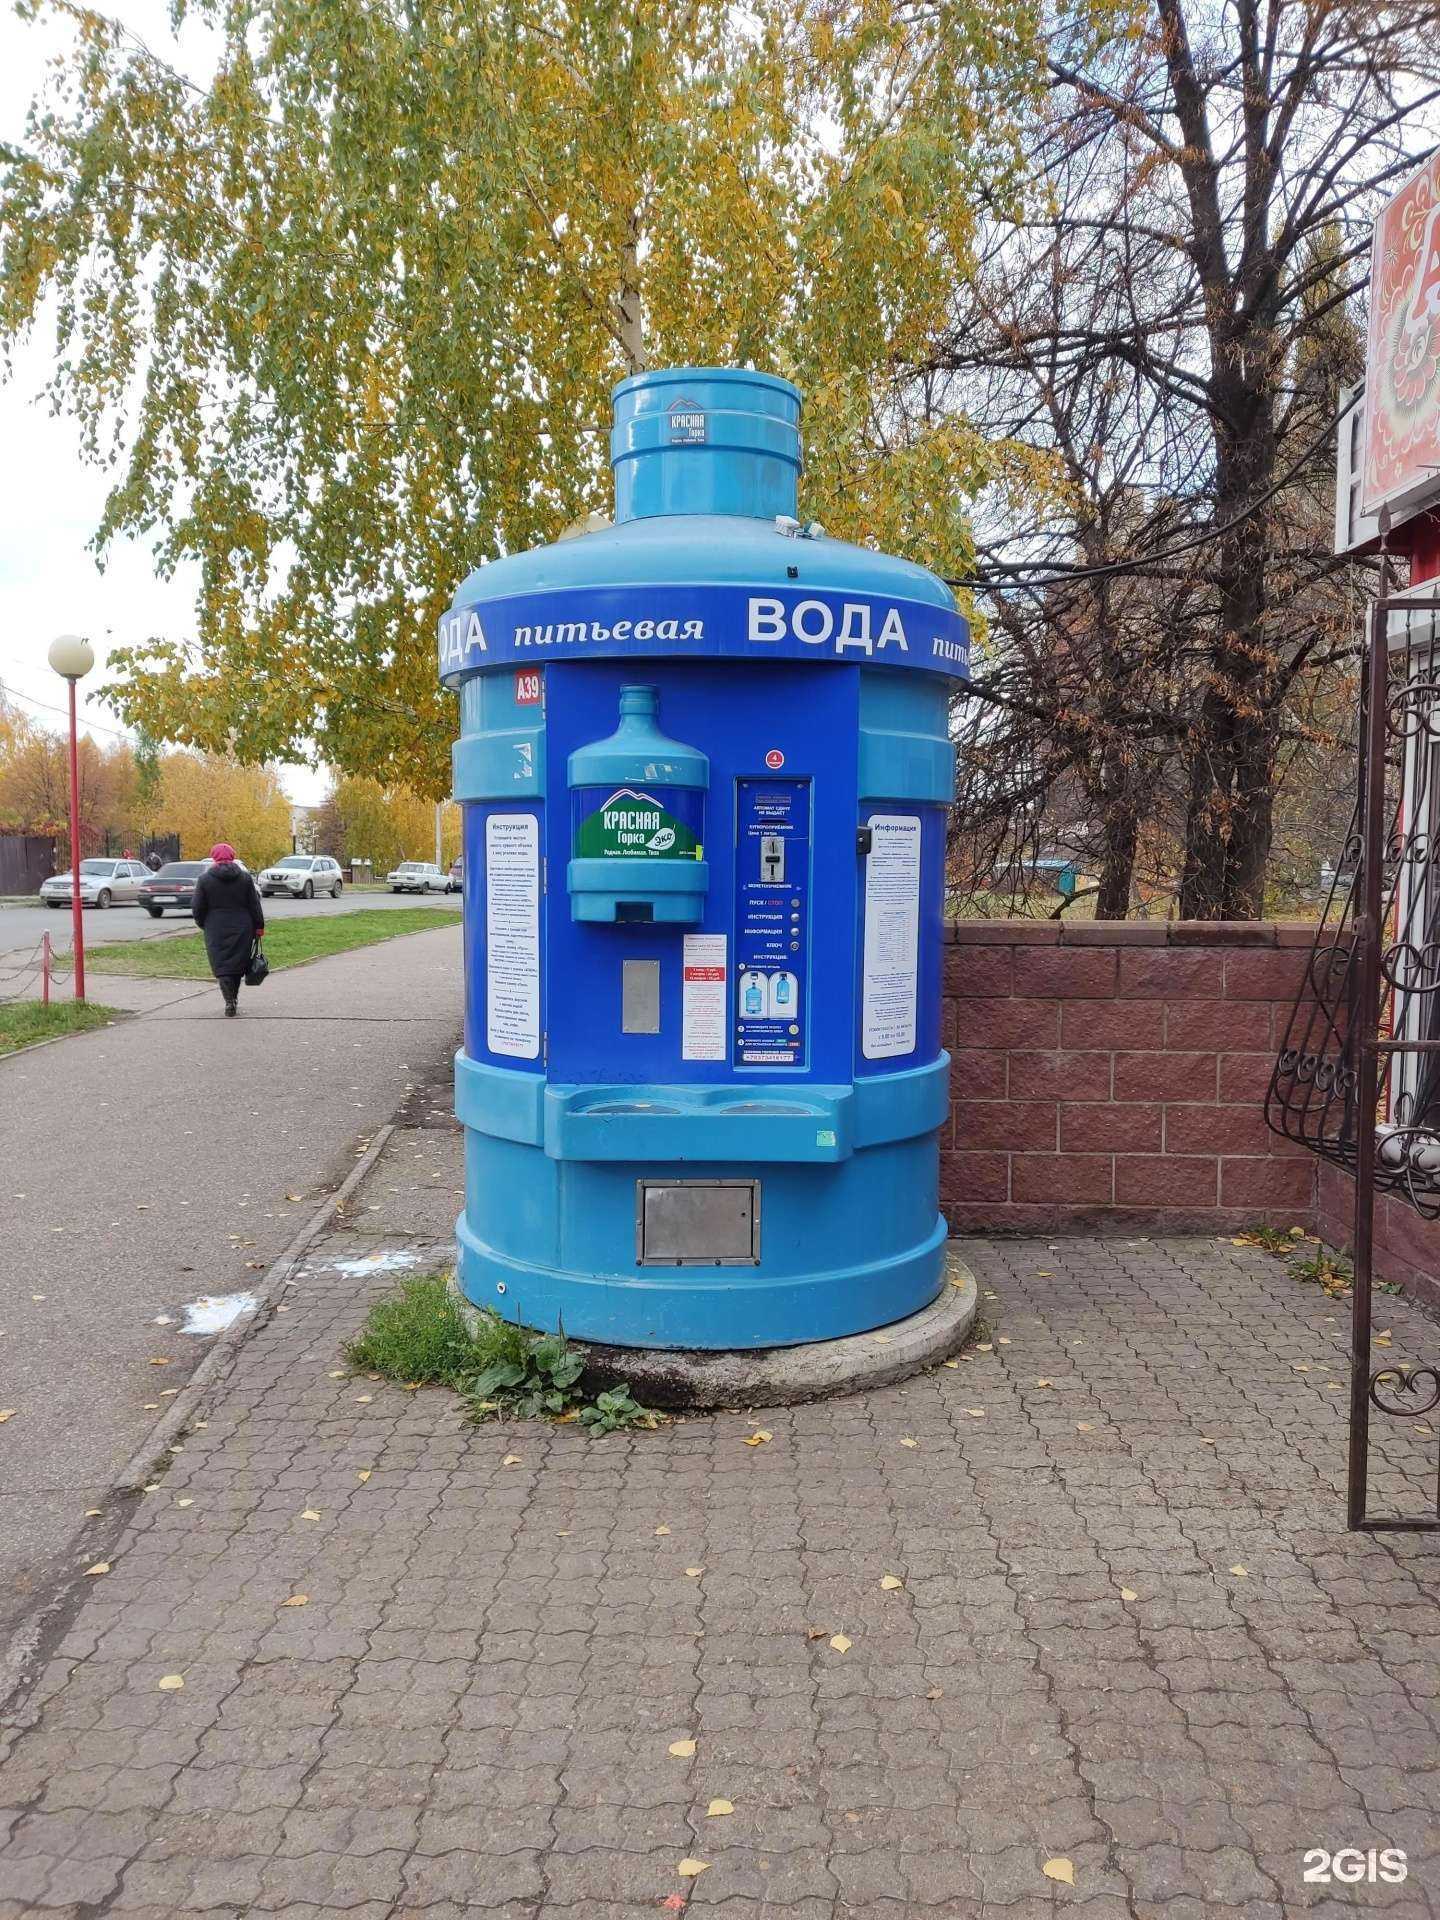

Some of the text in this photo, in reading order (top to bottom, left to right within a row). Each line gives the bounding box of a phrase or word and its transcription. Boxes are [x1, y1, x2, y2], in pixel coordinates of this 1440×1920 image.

[514, 618, 705, 647] питьевая
[748, 597, 909, 656] ВОДА
[492, 824, 529, 832] Инструкция
[603, 811, 660, 830] КРАСНАЯ
[874, 823, 917, 832] Информация
[617, 831, 645, 846] Горка
